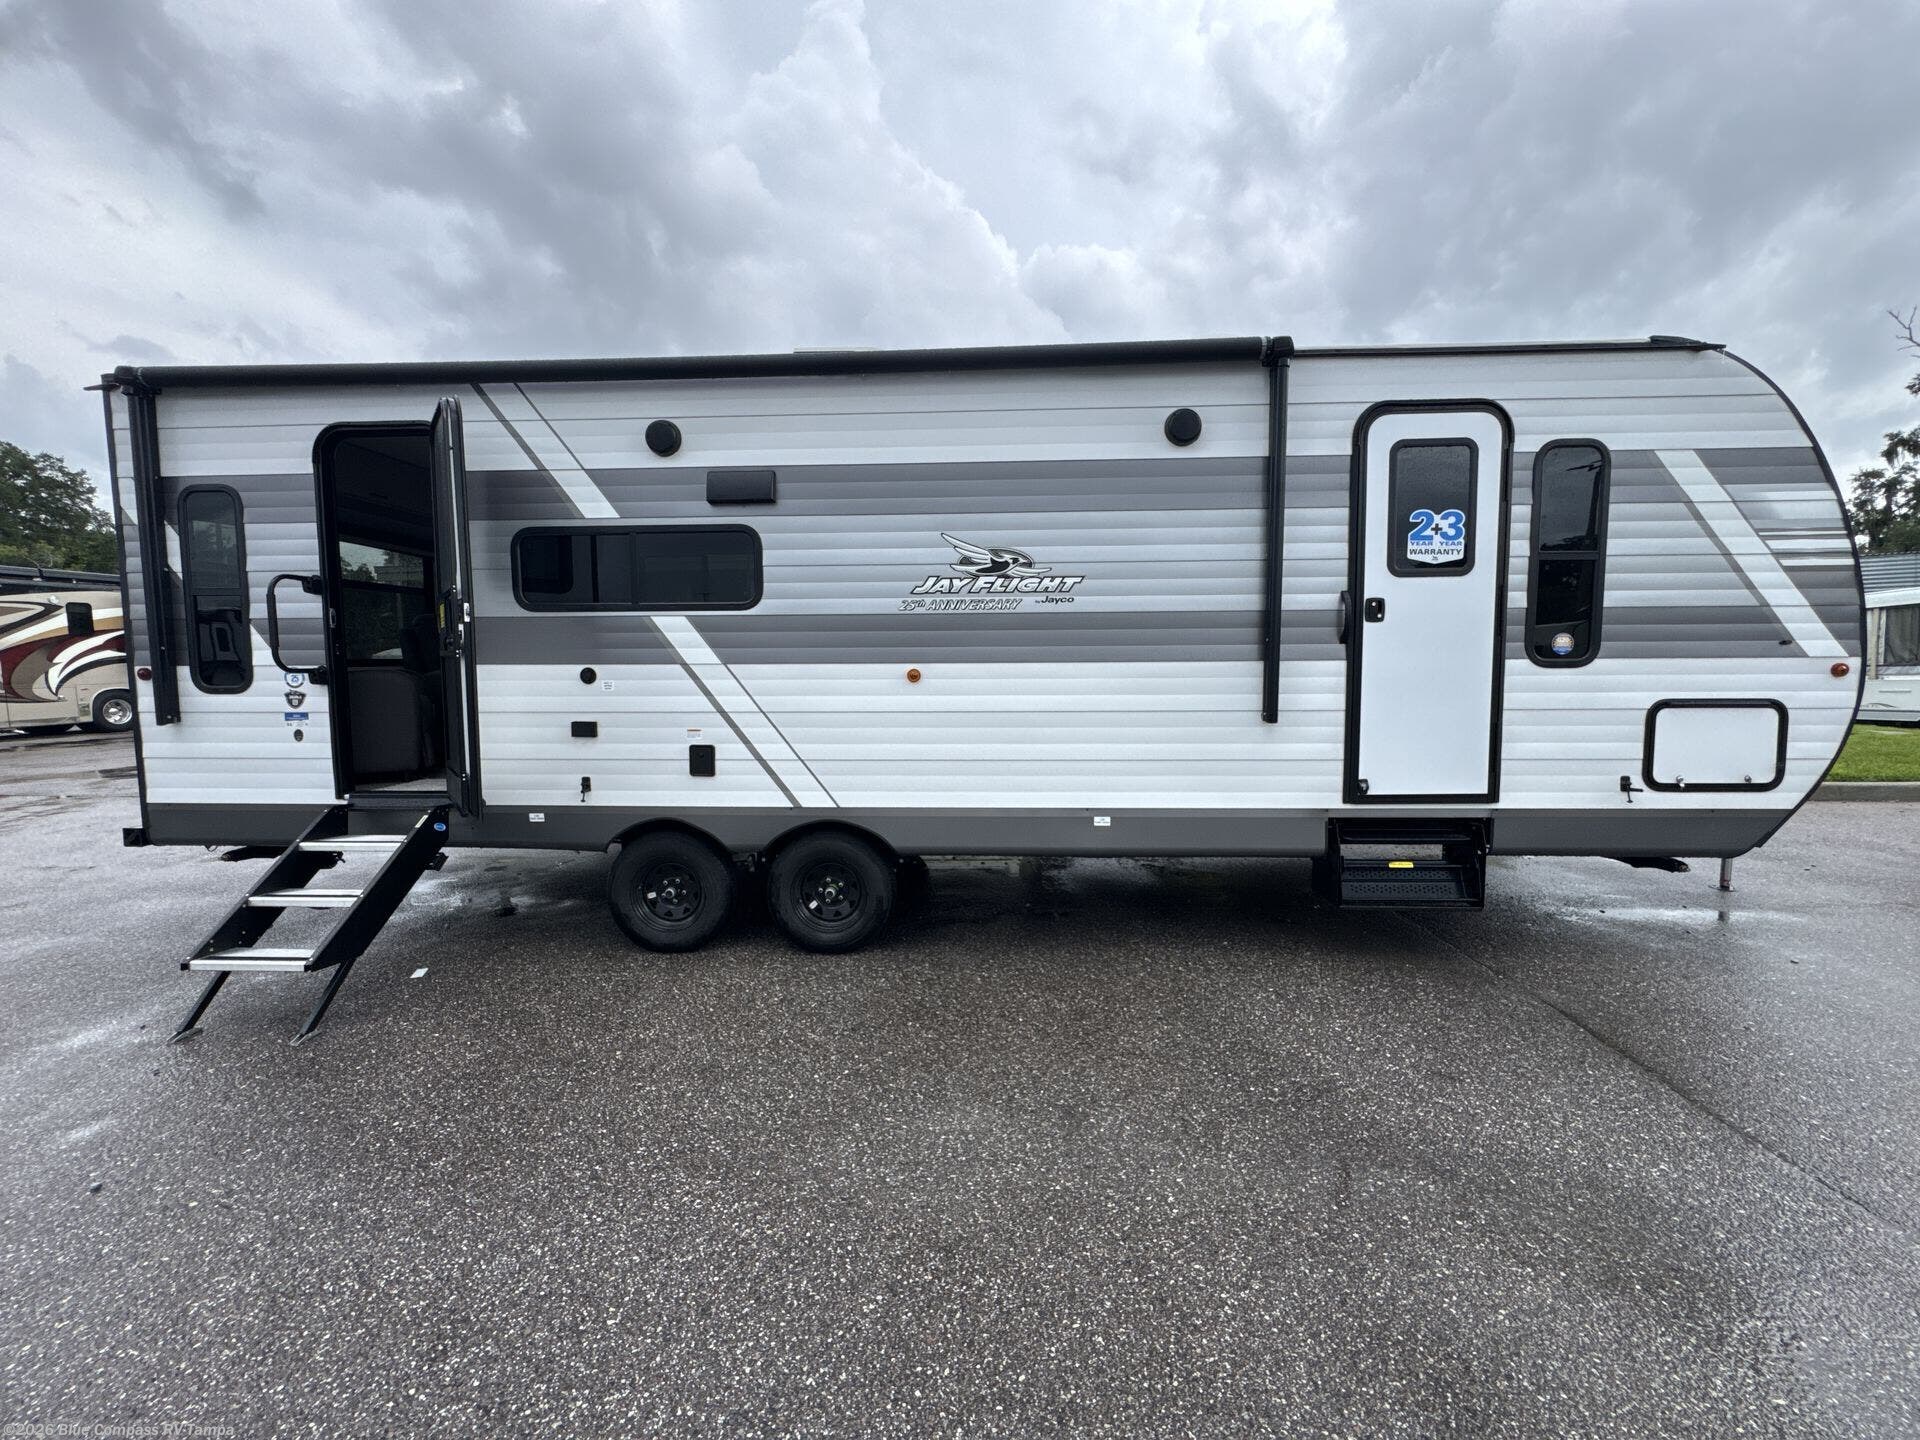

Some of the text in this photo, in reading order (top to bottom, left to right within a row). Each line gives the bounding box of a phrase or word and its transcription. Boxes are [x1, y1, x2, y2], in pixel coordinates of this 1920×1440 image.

[911, 575, 1085, 594] JAY FLIGHT
[899, 598, 1023, 612] 25th ANNIVERSARY
[1041, 595, 1075, 605] Jayco
